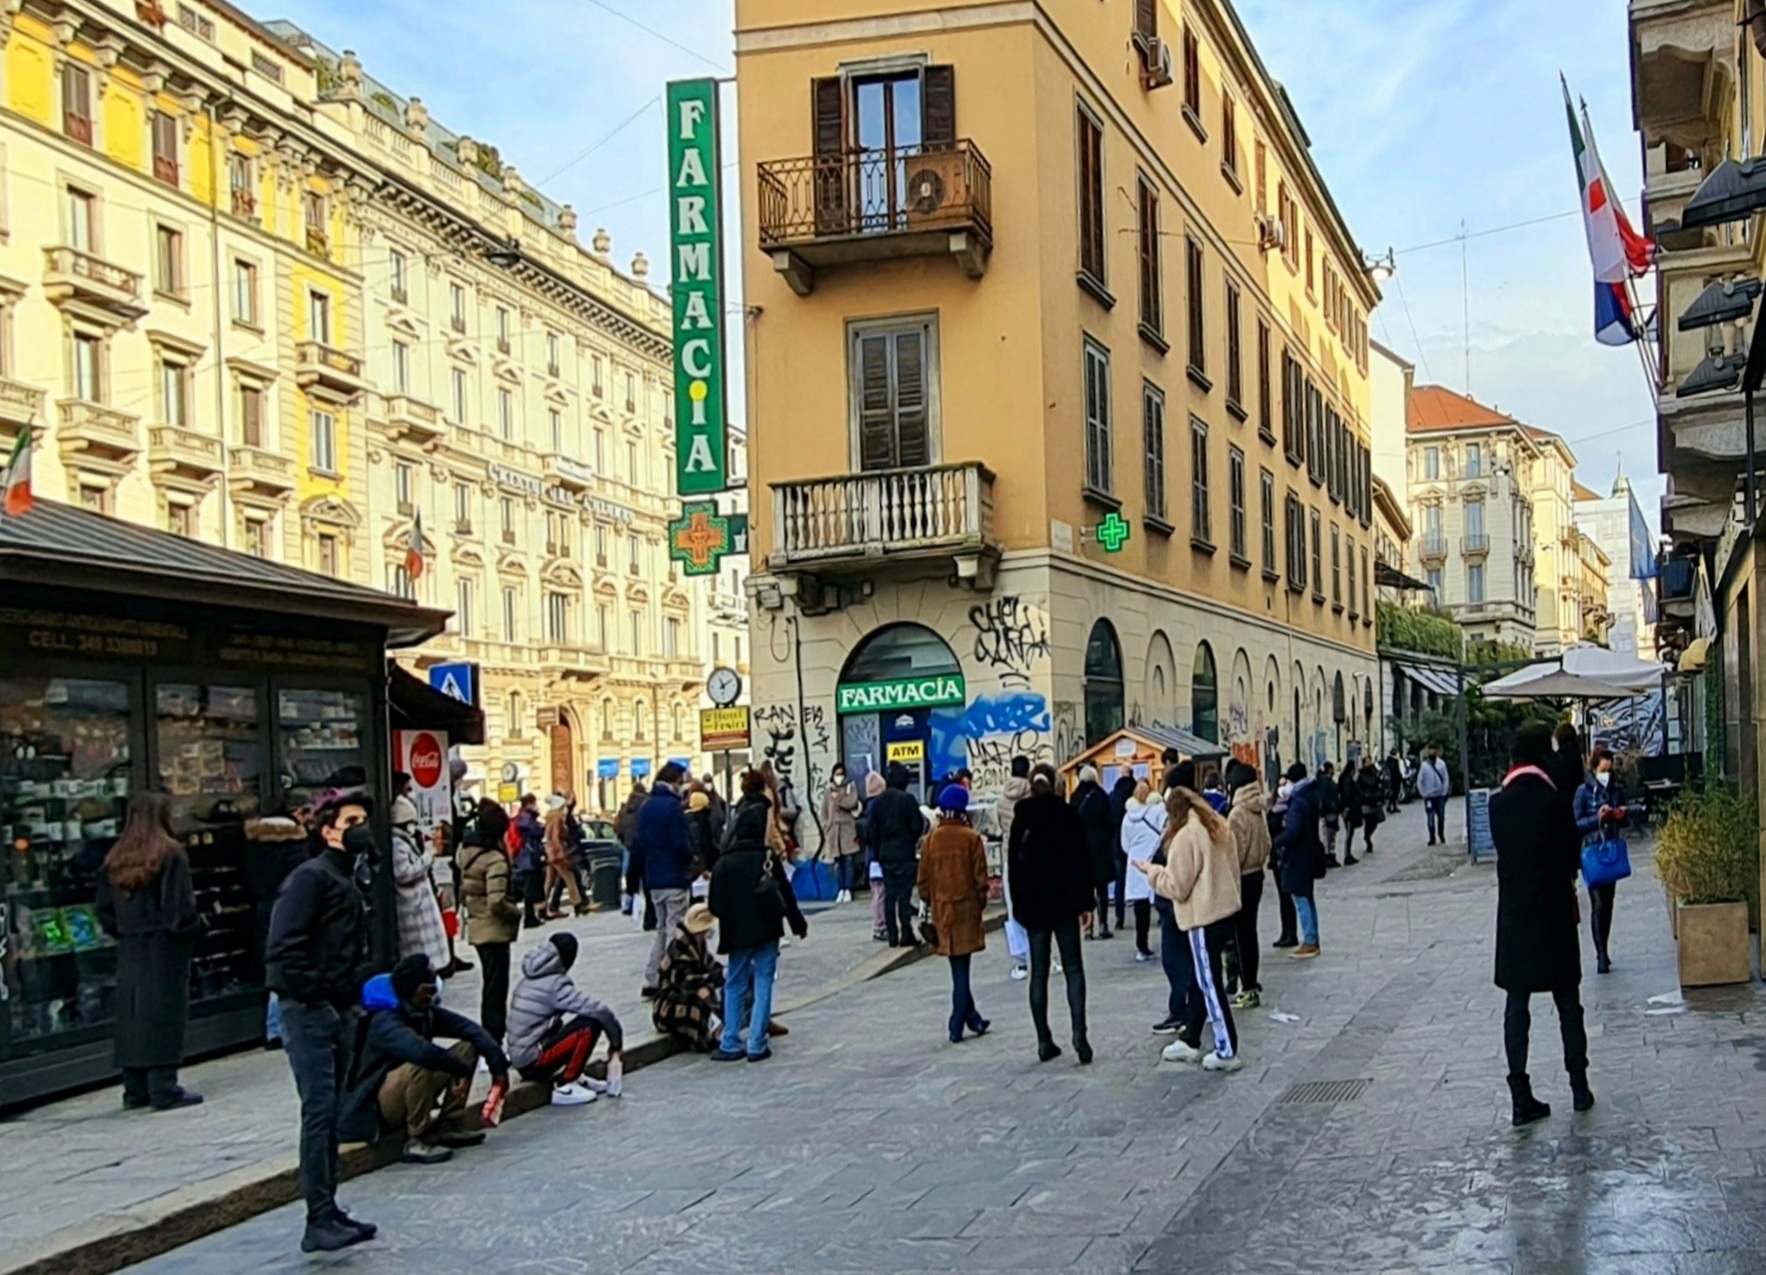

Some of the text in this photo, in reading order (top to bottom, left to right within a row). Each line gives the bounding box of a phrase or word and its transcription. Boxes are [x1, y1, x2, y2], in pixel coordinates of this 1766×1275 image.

[676, 100, 717, 474] FARMACIA
[841, 677, 962, 708] FARMACIA
[891, 745, 920, 758] ATM
